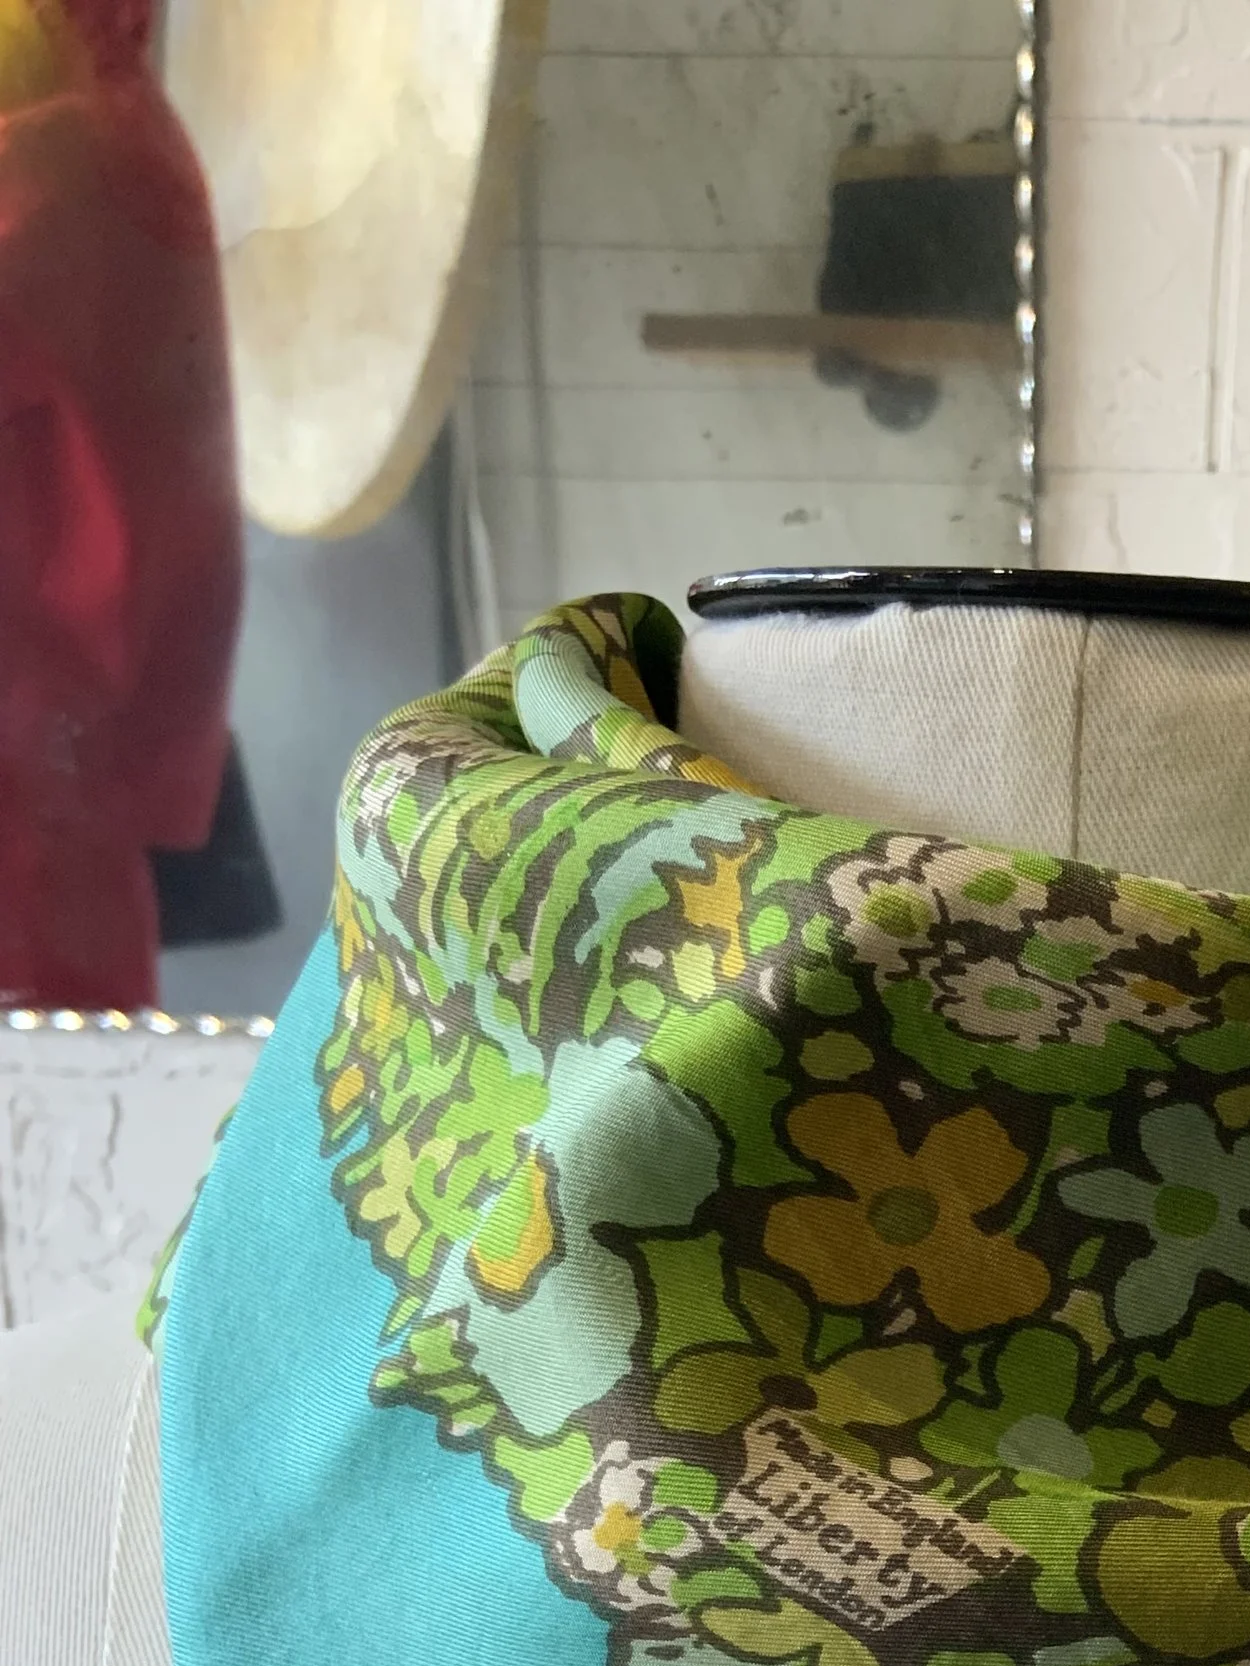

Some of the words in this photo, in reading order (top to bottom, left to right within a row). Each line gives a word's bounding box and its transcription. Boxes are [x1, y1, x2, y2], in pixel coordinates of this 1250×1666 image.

[713, 1511, 764, 1543] of
[757, 1533, 886, 1629] London
[738, 1460, 947, 1607] Liberty
[757, 1418, 842, 1482] Made
[838, 1470, 875, 1500] in
[867, 1486, 1014, 1578] England
